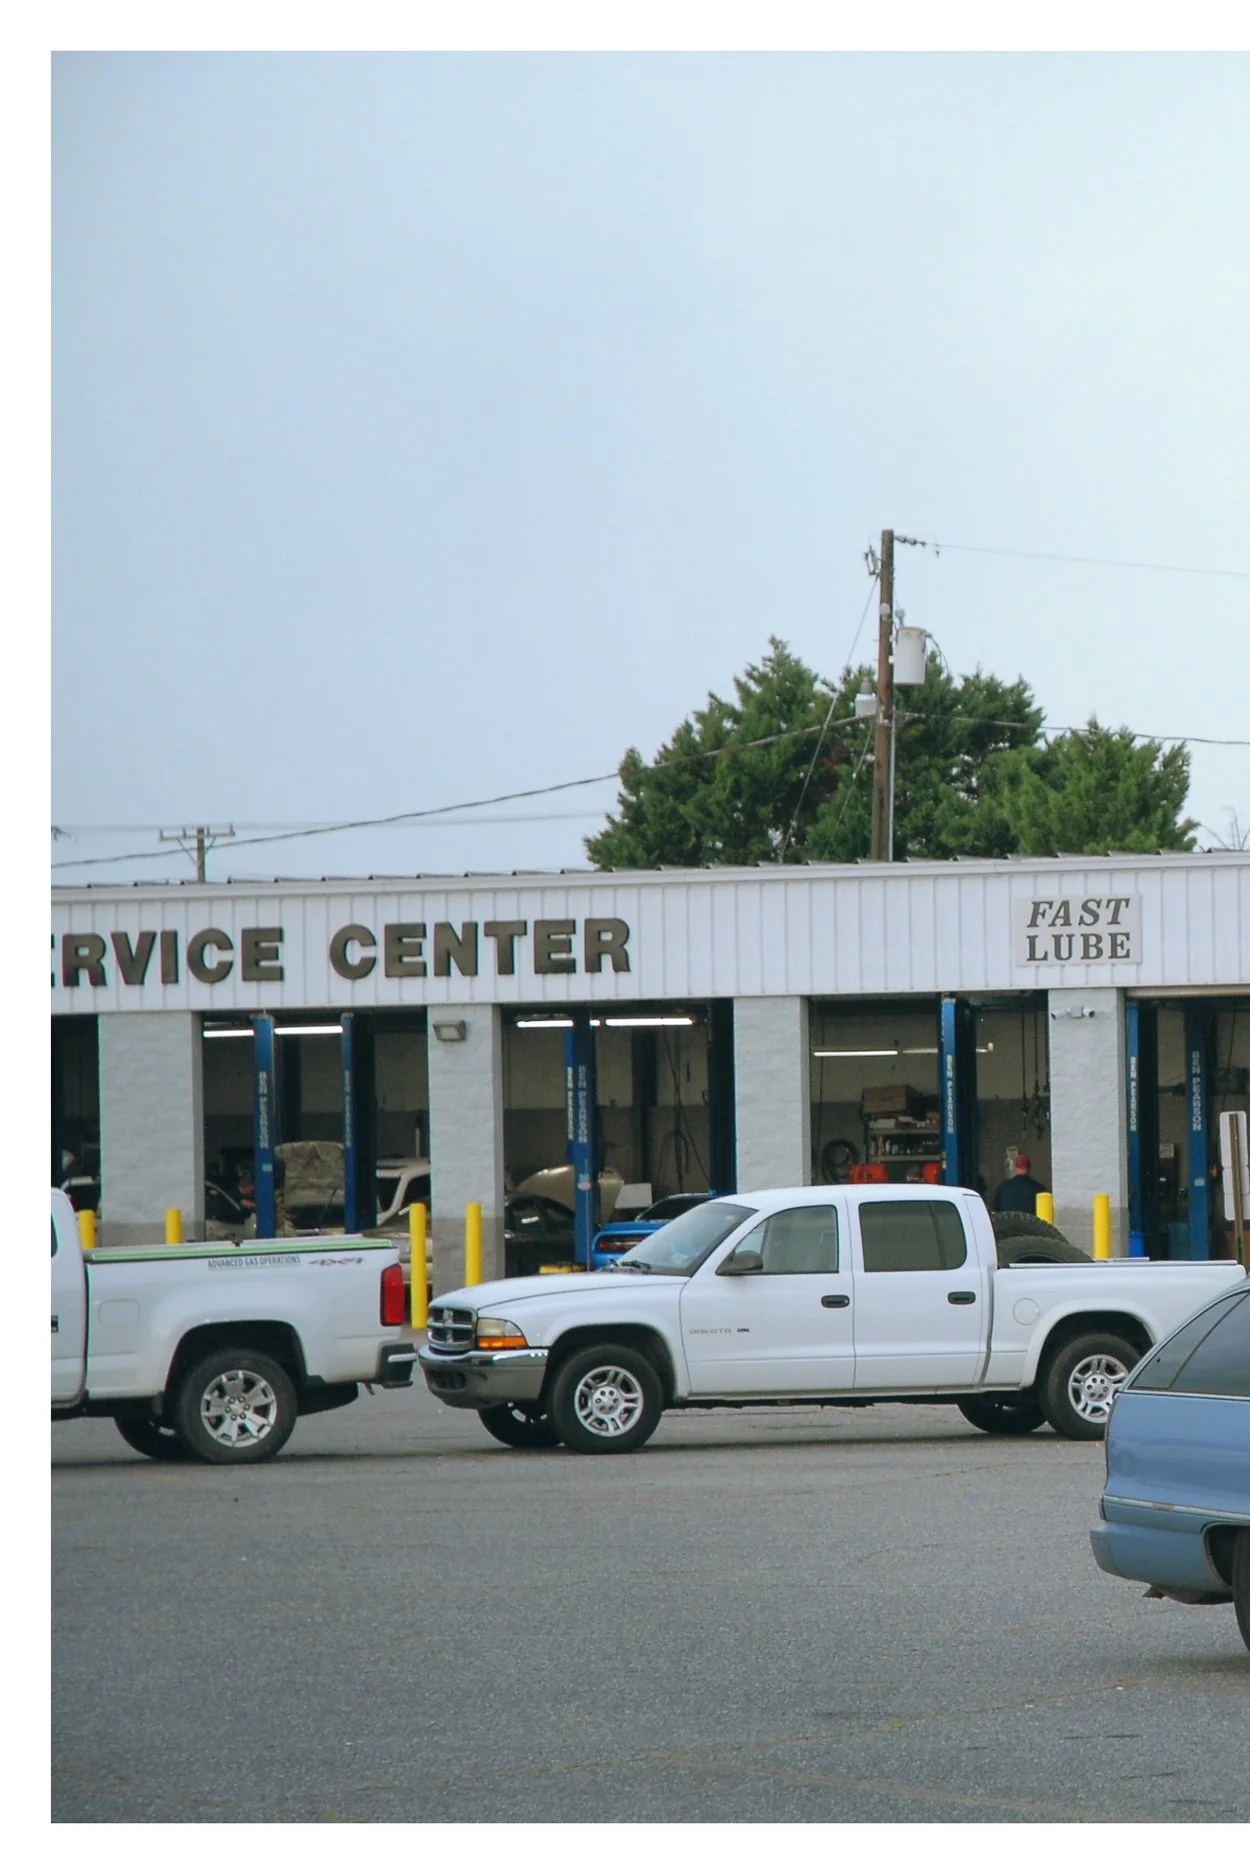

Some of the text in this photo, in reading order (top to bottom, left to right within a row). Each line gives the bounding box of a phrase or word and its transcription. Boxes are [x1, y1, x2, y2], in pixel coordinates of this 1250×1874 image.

[1026, 898, 1131, 929] FAST
[50, 917, 632, 988] RVICE CENTER
[1026, 932, 1131, 962] LUBE
[207, 1257, 244, 1269] ADVANCED
[245, 1256, 259, 1267] GAS
[260, 1254, 301, 1266] OPERATIONS
